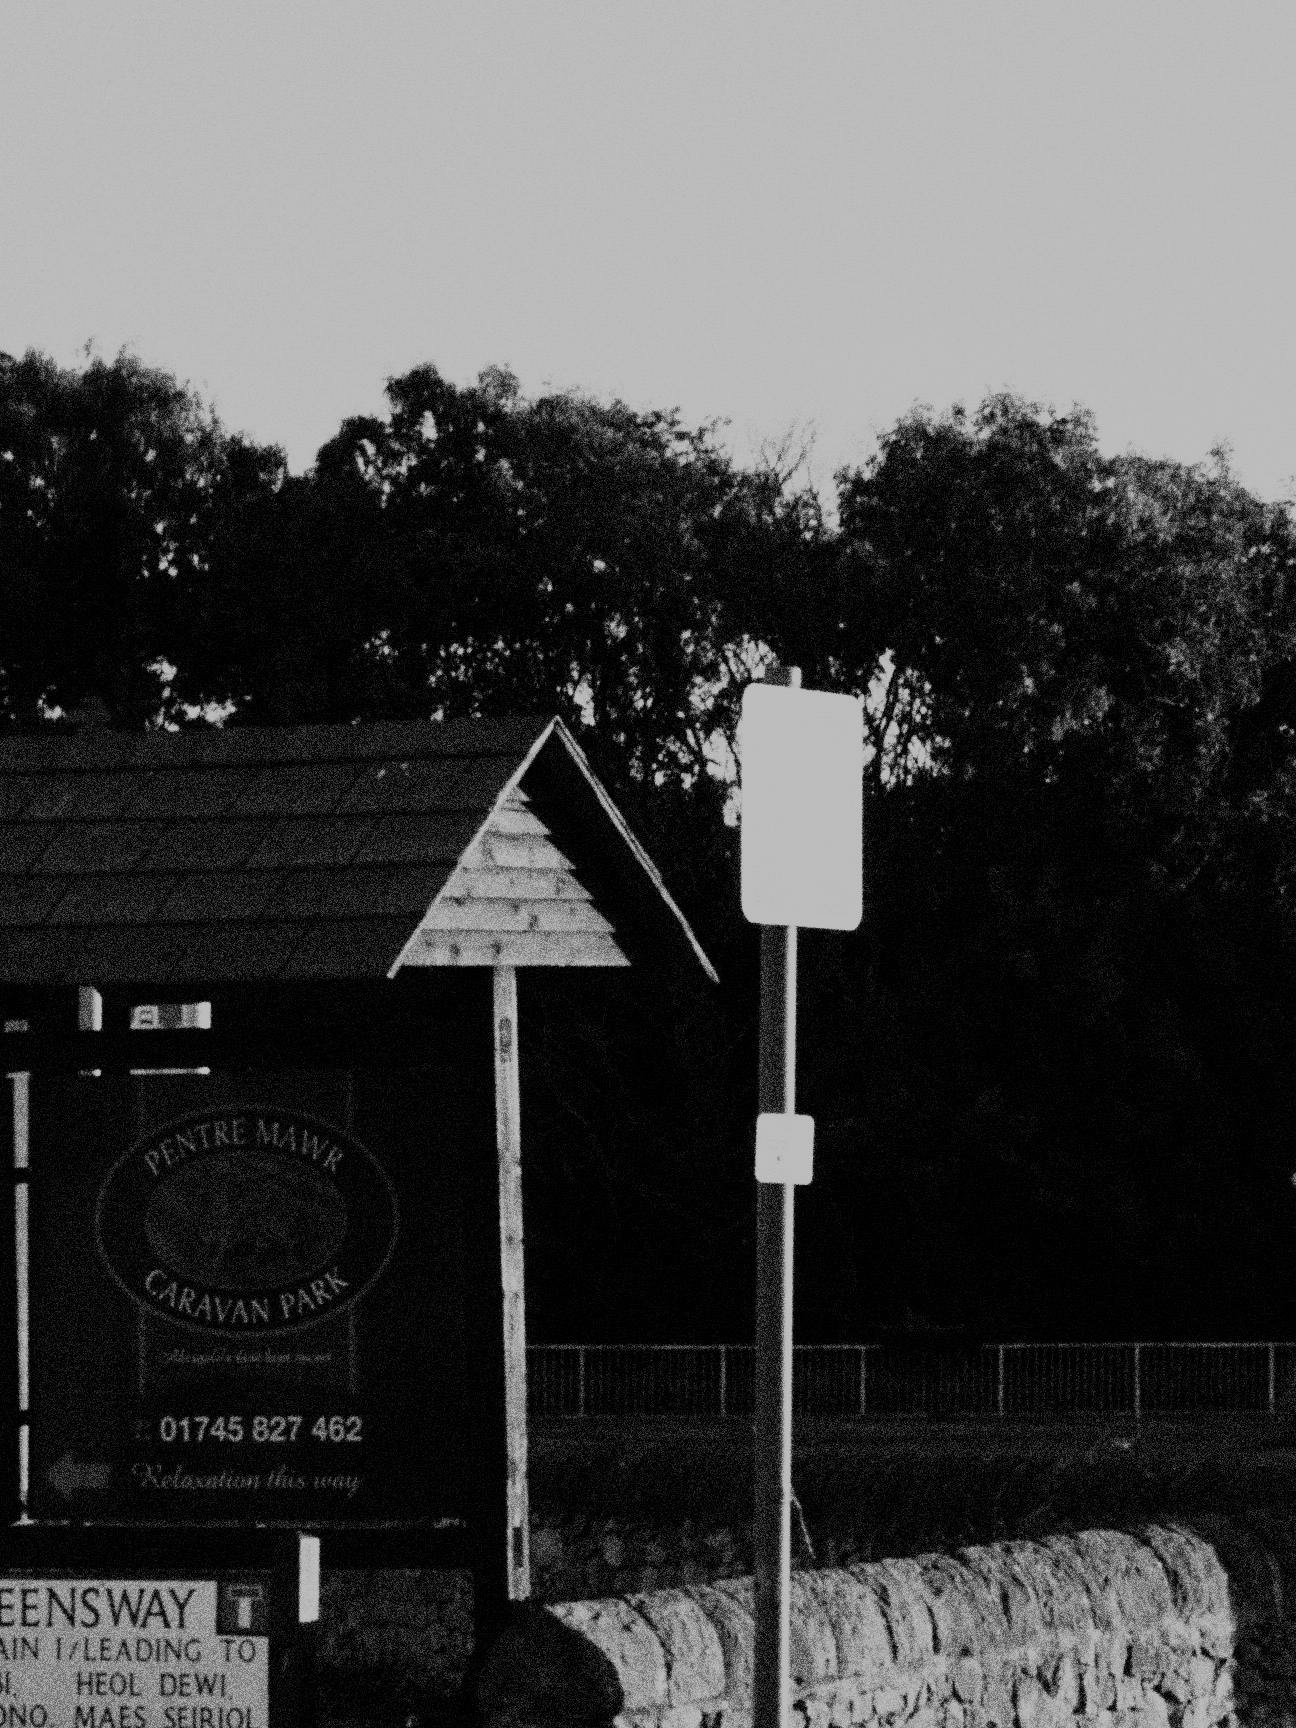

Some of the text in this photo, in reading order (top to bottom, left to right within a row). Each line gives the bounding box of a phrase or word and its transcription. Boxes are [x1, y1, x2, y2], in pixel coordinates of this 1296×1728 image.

[143, 1117, 345, 1176] PENTRE MAWR
[144, 1266, 350, 1324] CARAVAN PARK
[159, 1415, 244, 1442] 01745
[252, 1415, 302, 1442] 827
[311, 1415, 363, 1442] 462
[131, 1461, 360, 1499] Relaxation this way
[220, 1638, 257, 1664] TO
[76, 1671, 143, 1697] HEOL
